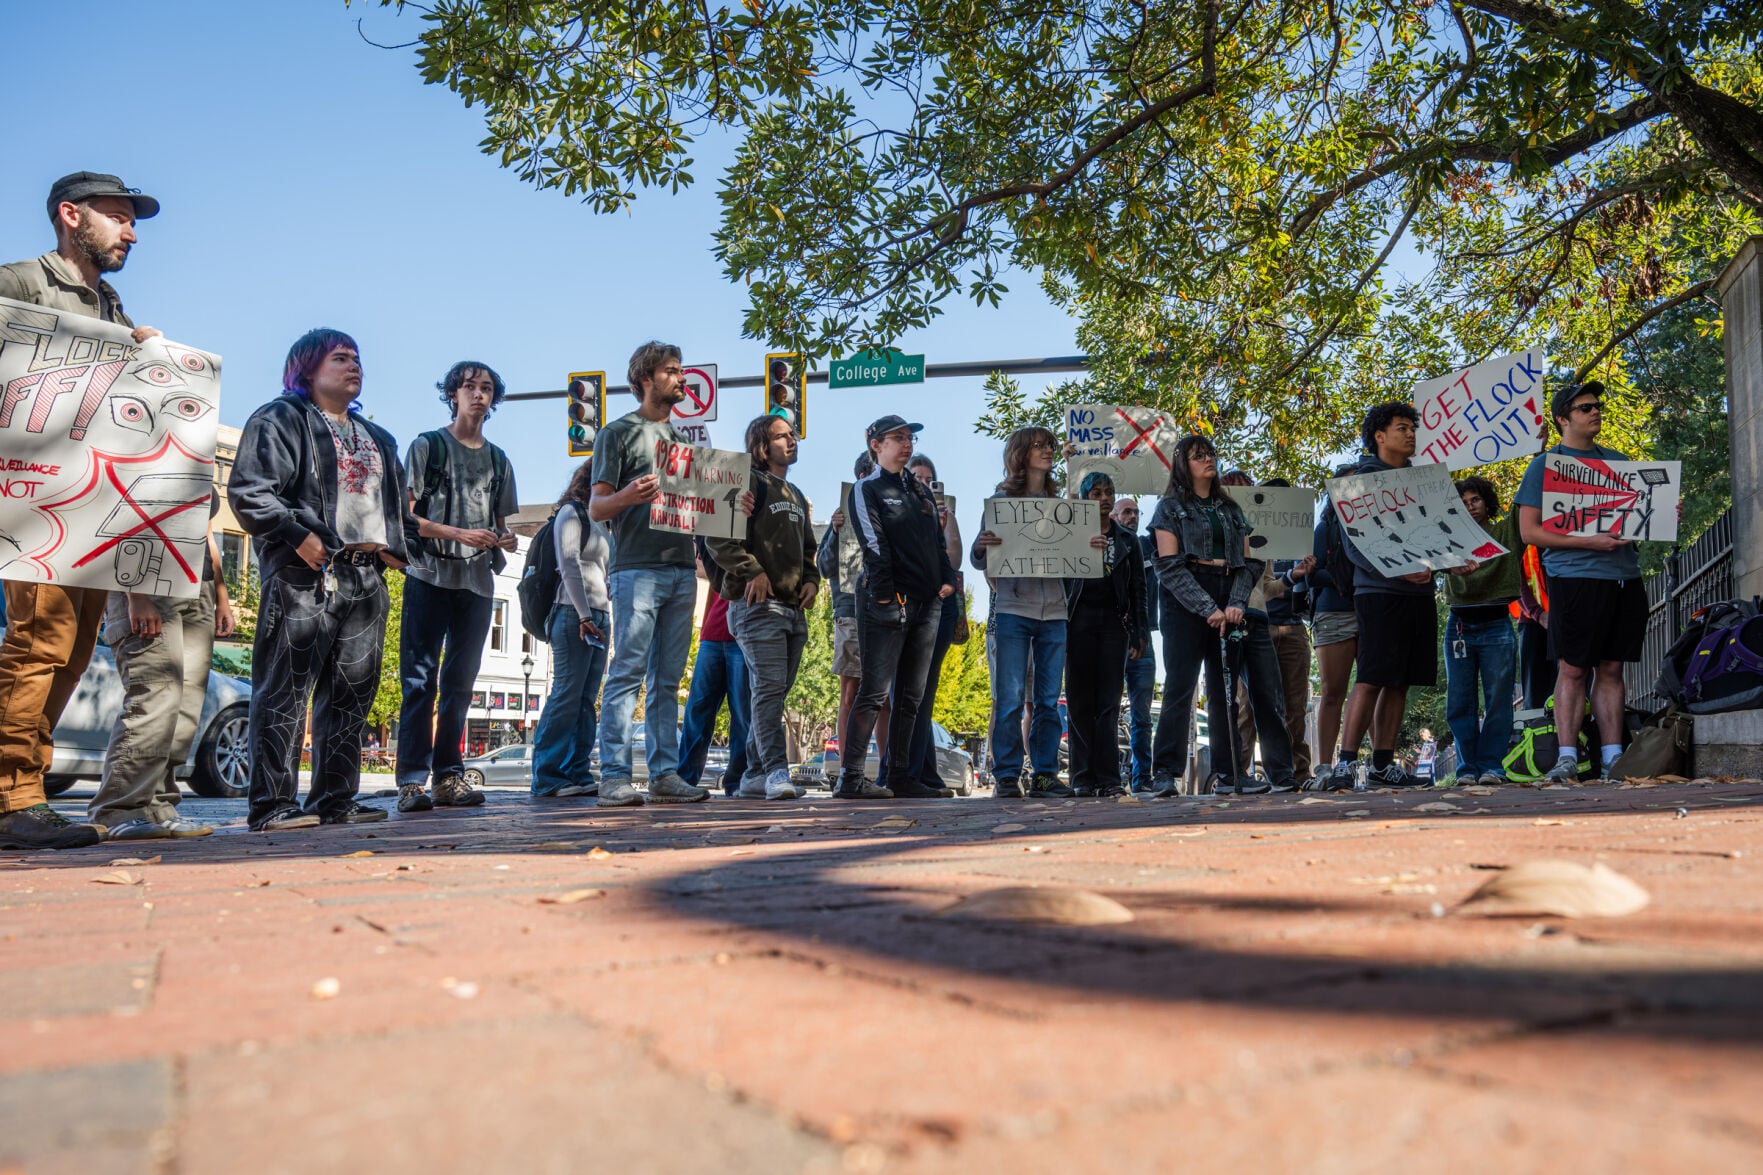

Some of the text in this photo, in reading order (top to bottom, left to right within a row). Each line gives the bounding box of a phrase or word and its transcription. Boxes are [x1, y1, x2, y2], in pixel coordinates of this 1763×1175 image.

[0, 304, 142, 372] FLOCK
[836, 365, 917, 383] College Ave
[0, 360, 129, 441] FF!
[1070, 409, 1095, 426] NO
[1420, 353, 1542, 464] THE FLOCK
[1422, 370, 1472, 430] GET
[1069, 426, 1114, 443] MASS
[1473, 397, 1543, 462] OUT!
[656, 439, 694, 478] 1984
[1553, 460, 1638, 491] SURVEILLANCE
[993, 501, 1095, 526] EYES OFF
[1336, 486, 1417, 524] DEFLOCK
[1572, 488, 1622, 506] IS NOT
[1552, 501, 1655, 536] SAFETY
[998, 557, 1091, 575] ATHENS
